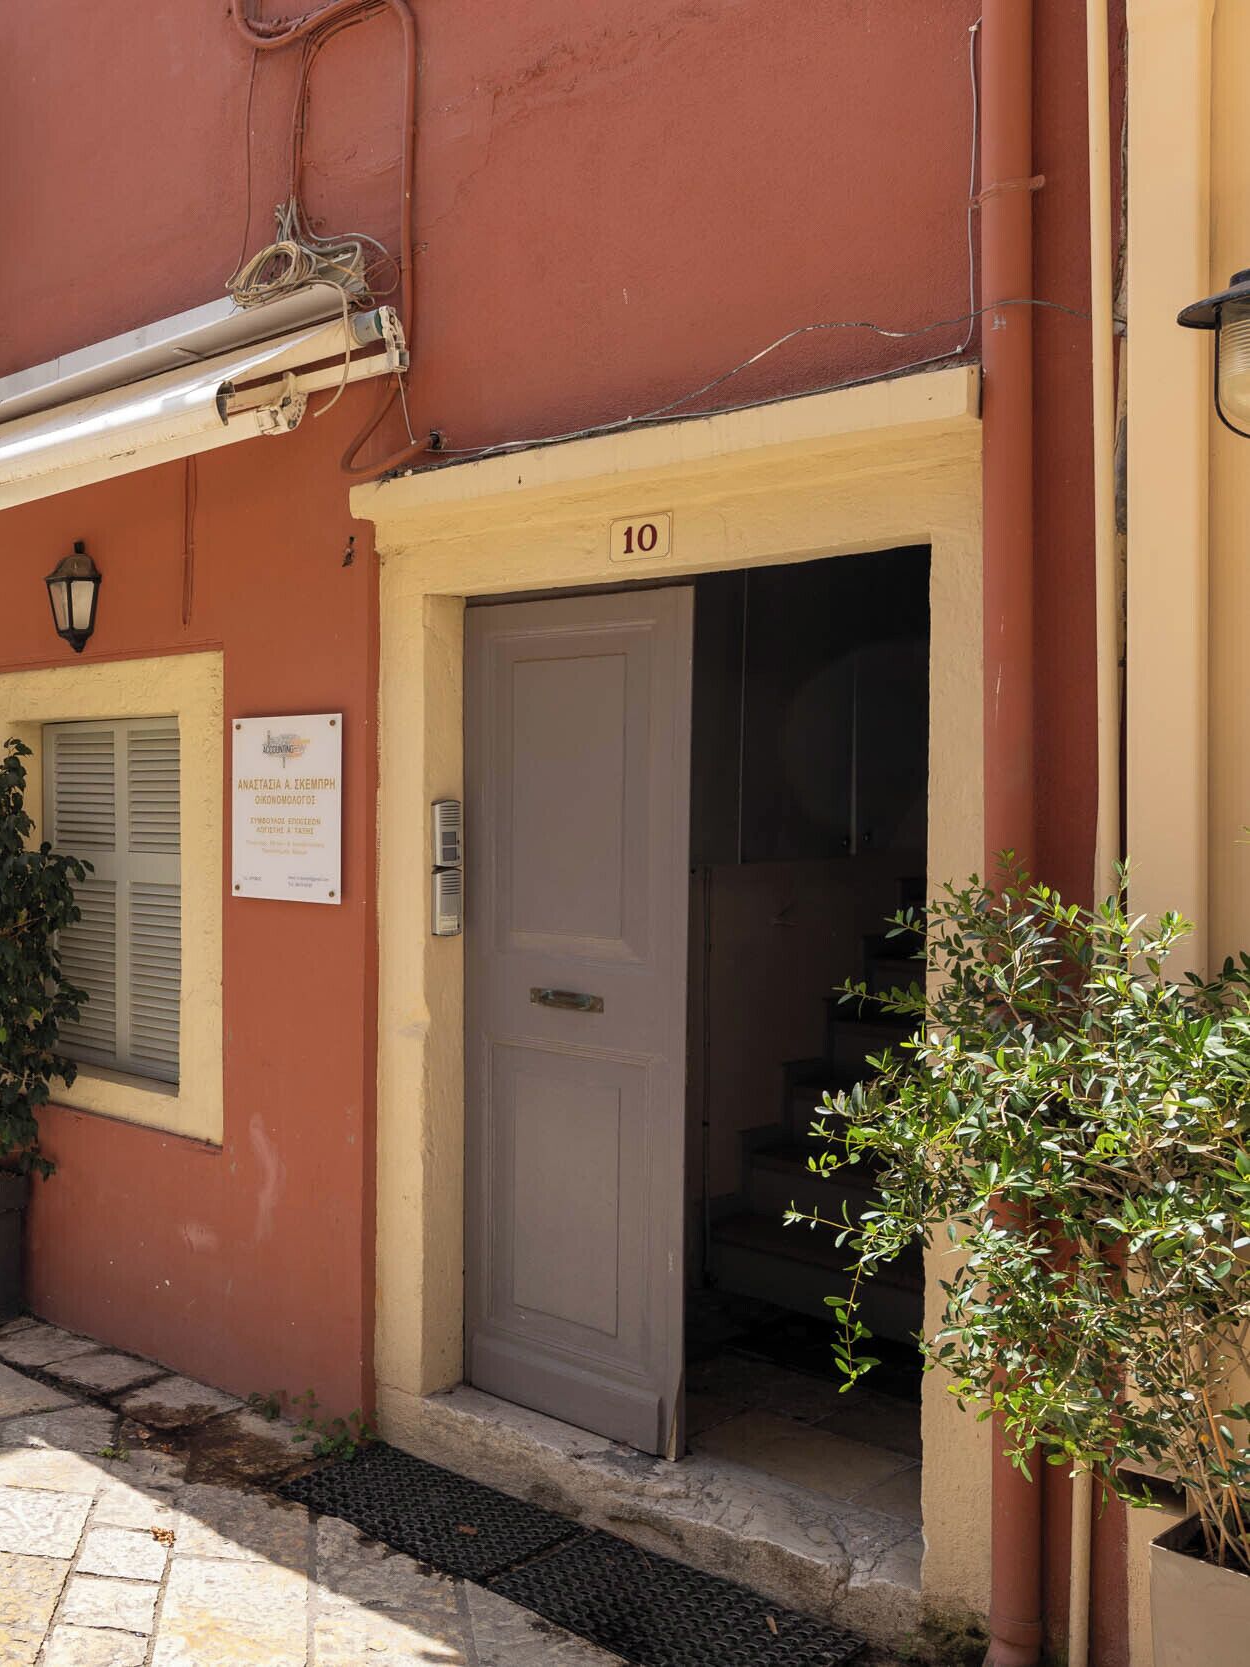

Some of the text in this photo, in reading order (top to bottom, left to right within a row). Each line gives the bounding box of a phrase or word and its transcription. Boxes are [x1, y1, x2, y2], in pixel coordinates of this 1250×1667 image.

[623, 523, 658, 554] 10
[238, 778, 281, 790] ΑΝΑΣΤΑΣΙΑ
[294, 778, 335, 790] ΣΚΕΜΠΡΗ
[254, 795, 316, 805] ΟΙΚΟΝΟΜΟΛΟΓΟΣ
